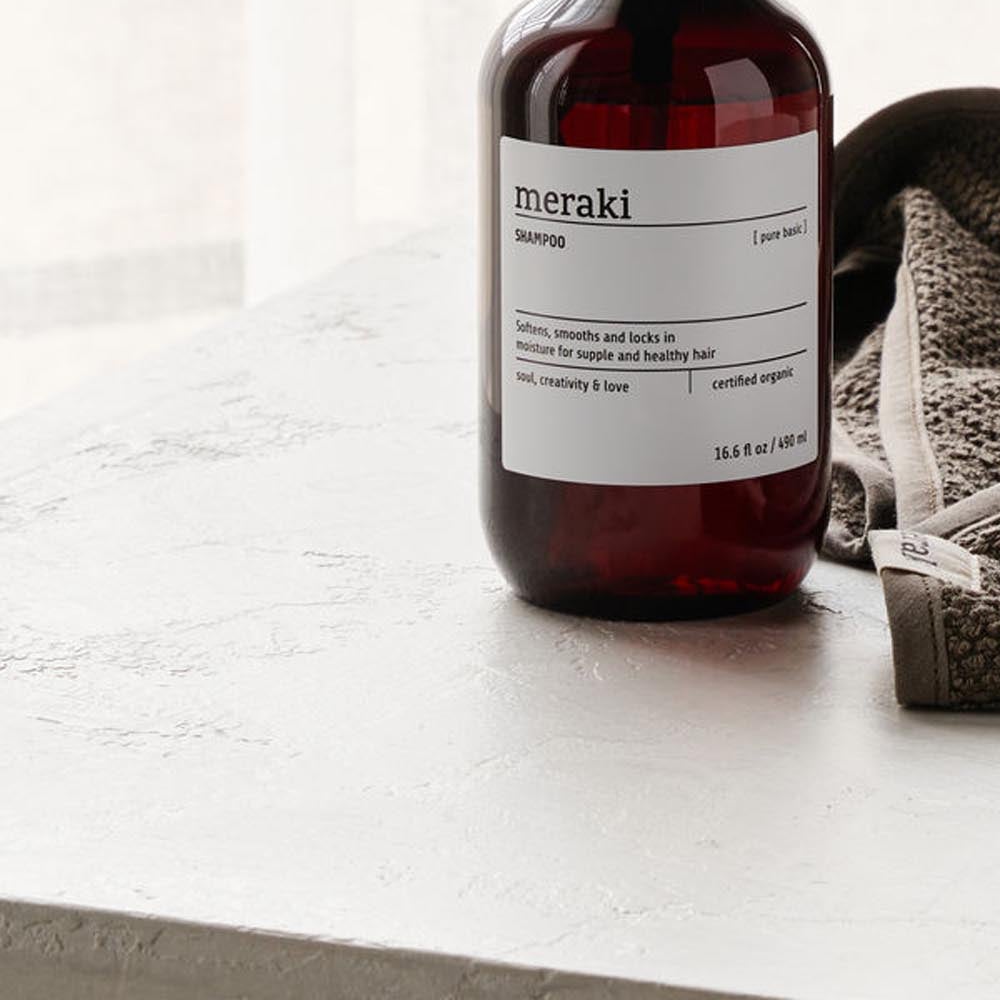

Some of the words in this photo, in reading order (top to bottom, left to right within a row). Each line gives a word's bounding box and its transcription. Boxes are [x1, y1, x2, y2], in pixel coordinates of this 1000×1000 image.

[514, 184, 632, 219] meraki
[514, 228, 566, 249] SHAMPOO
[760, 230, 781, 245] pure
[782, 223, 803, 238] basic
[515, 319, 551, 341] Softens,
[553, 328, 600, 343] smooths
[603, 330, 626, 344] and
[629, 330, 660, 344] locks
[663, 330, 676, 344] in
[515, 340, 556, 357] moisture
[558, 345, 575, 359] for
[576, 348, 615, 363] supple
[617, 349, 641, 363] and
[643, 348, 690, 364] healthy
[692, 346, 717, 360] hair
[515, 371, 538, 387] soul,
[540, 376, 590, 393] creativity
[592, 379, 601, 392] &
[603, 380, 630, 393] love
[711, 373, 758, 391] certified
[760, 365, 794, 385] organic
[713, 443, 741, 461] 16.6
[743, 443, 754, 458] fl
[755, 442, 769, 456] oz
[769, 436, 778, 455] /
[778, 433, 796, 450] 490
[797, 430, 808, 444] ml
